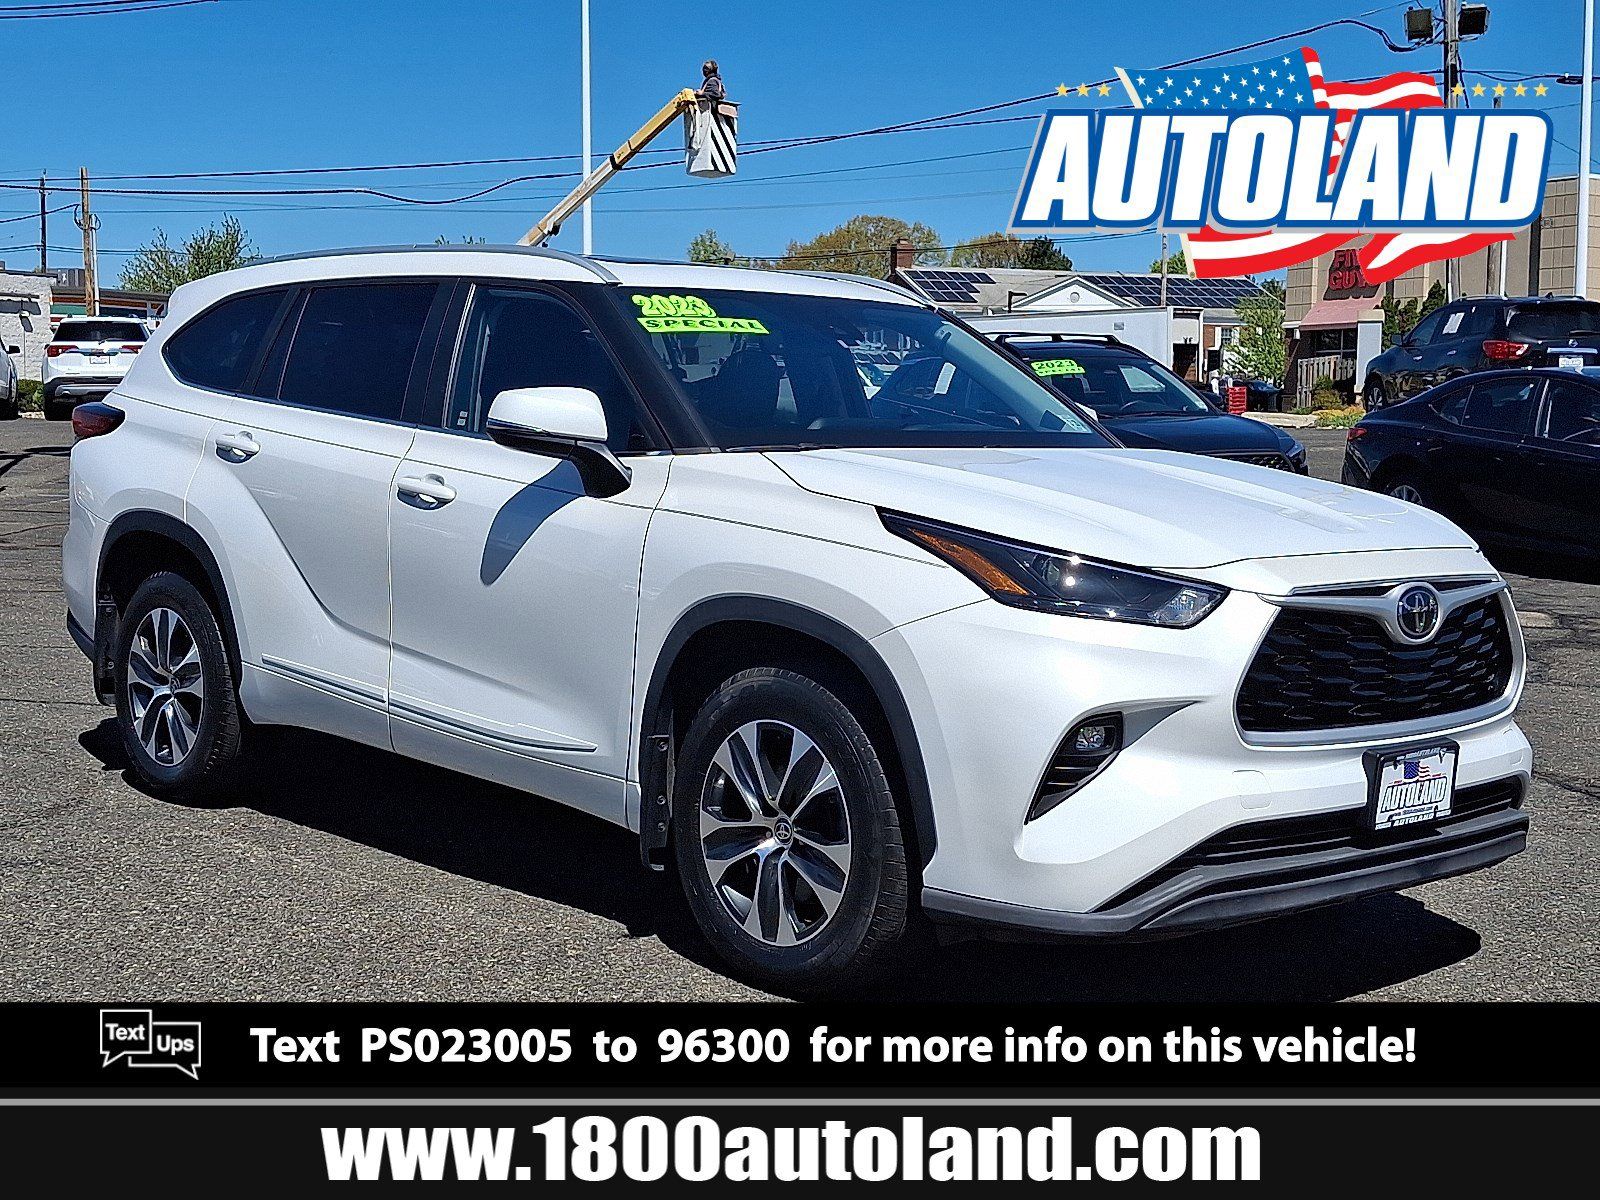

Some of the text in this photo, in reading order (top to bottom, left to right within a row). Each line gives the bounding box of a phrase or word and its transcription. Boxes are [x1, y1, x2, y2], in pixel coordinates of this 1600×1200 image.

[1329, 269, 1370, 291] GUY
[645, 319, 764, 331] SPECIAL
[1381, 777, 1447, 813] AUTOLAND
